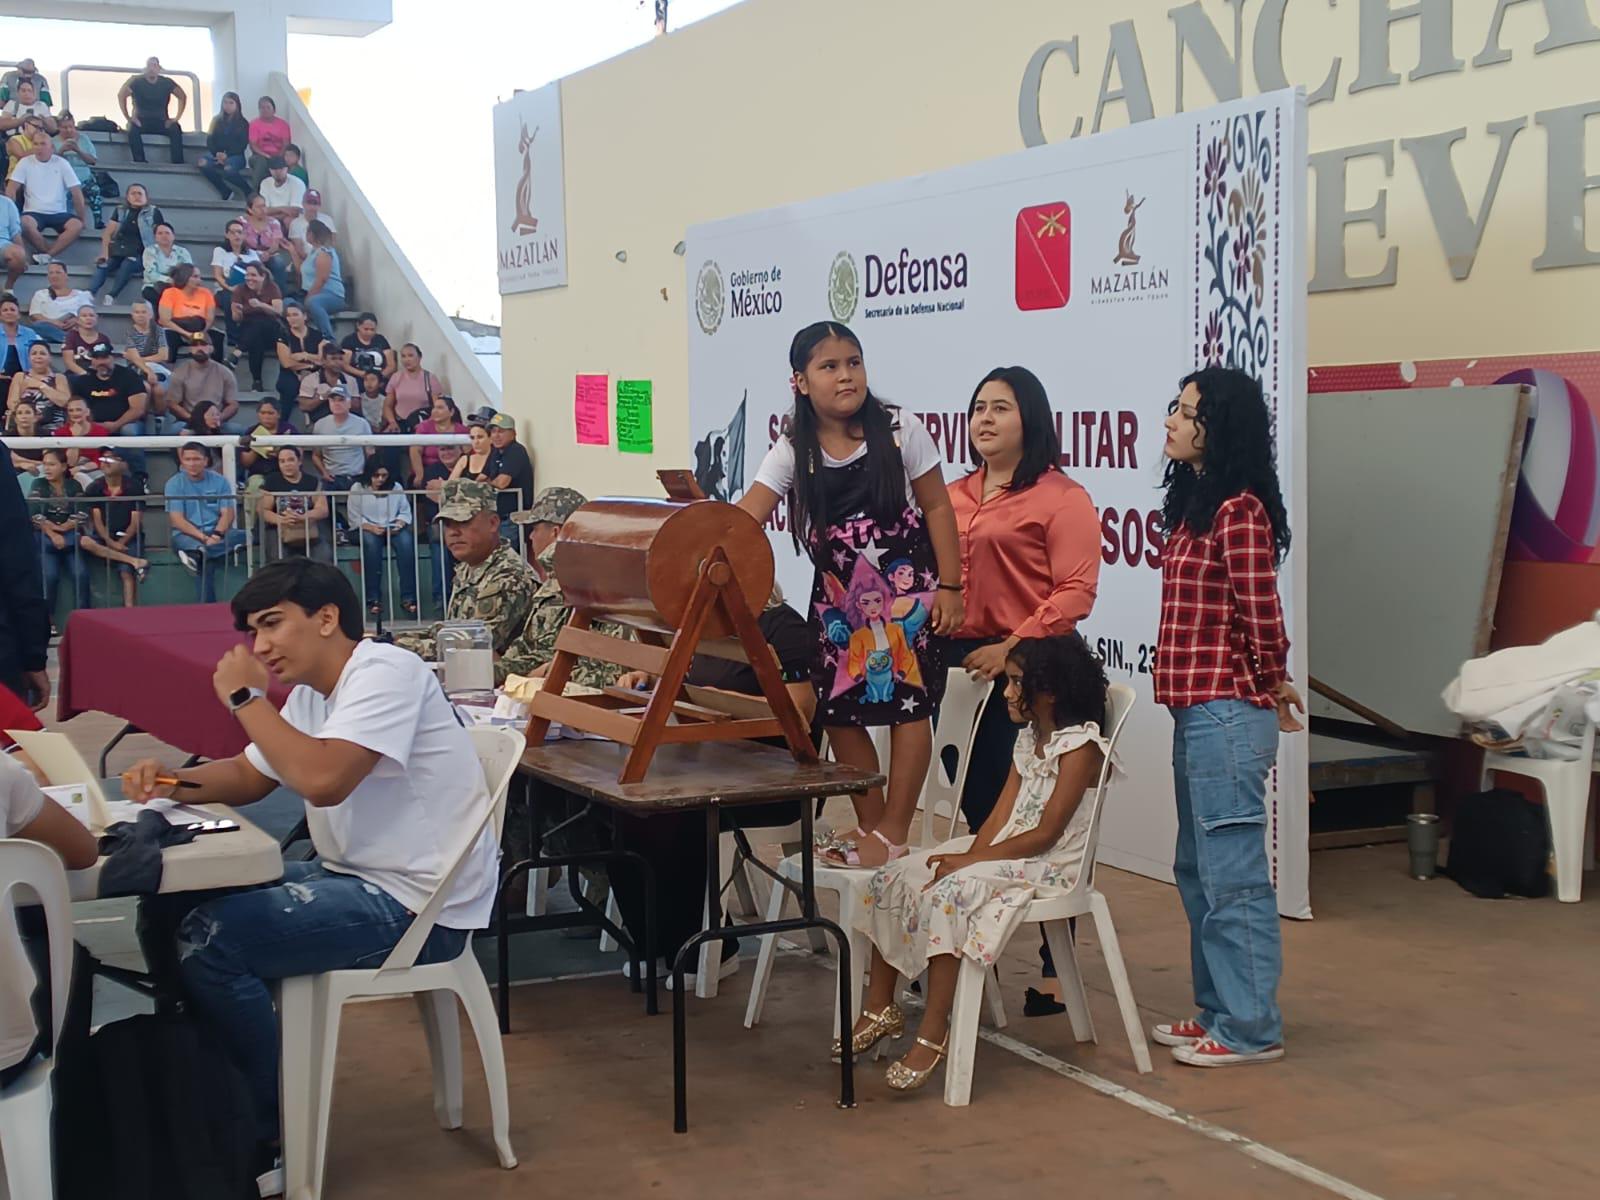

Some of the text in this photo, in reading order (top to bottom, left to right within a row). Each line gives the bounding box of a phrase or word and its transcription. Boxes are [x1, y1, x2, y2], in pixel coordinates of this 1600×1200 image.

[730, 265, 782, 287] Gobierno de
[864, 247, 968, 298] Defensa
[1090, 265, 1169, 295] MAZATLÁN
[731, 283, 782, 318] México
[895, 304, 902, 316] de
[911, 301, 935, 315] Defensa
[1096, 507, 1165, 570] SOS
